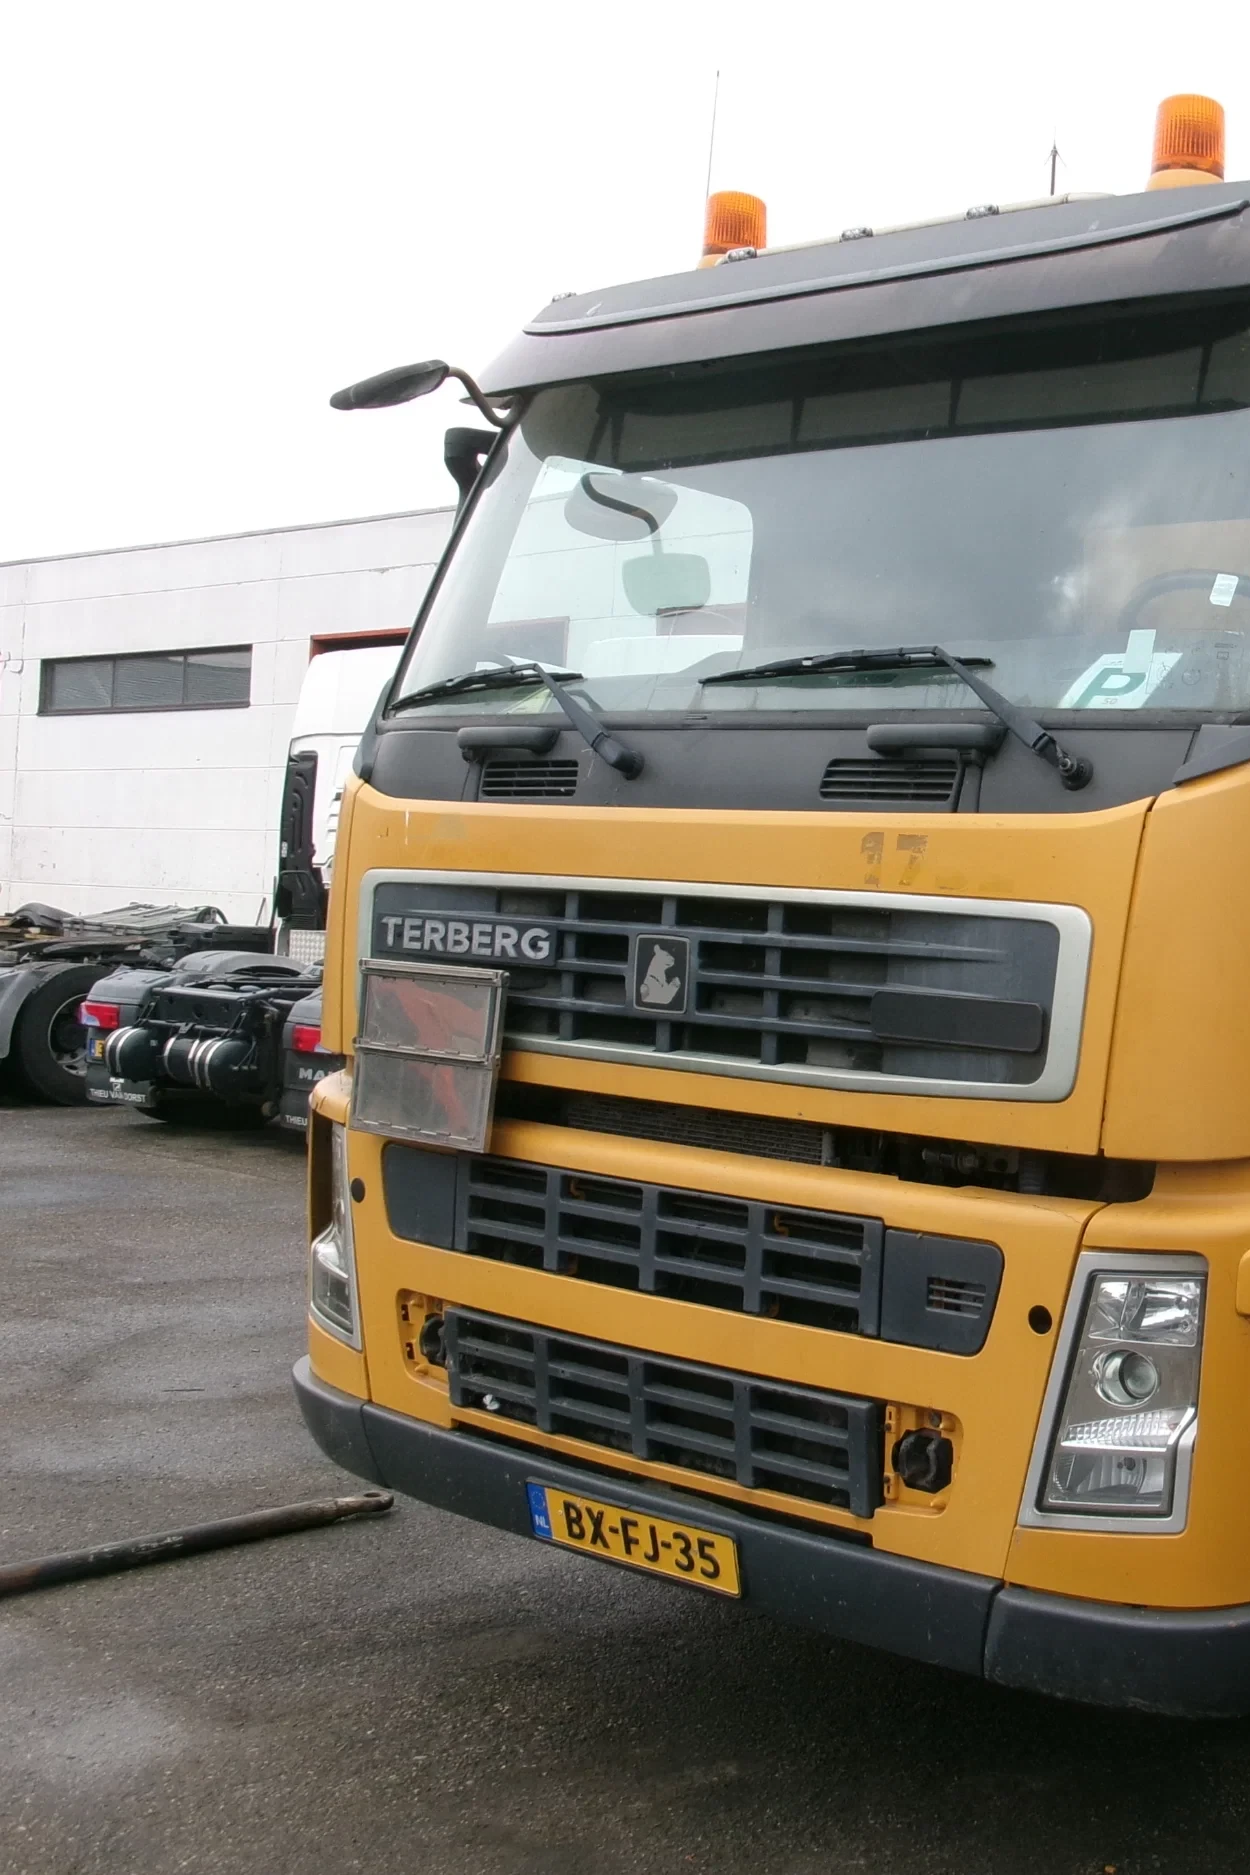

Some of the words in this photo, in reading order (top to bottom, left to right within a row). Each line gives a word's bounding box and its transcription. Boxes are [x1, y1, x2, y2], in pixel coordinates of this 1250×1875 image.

[380, 915, 550, 960] TERBERG
[298, 1067, 334, 1081] MA
[89, 1088, 108, 1098] THIEU
[285, 1114, 308, 1126] THIEU
[534, 1513, 550, 1530] NL
[562, 1499, 721, 1580] BX-FJ-35
